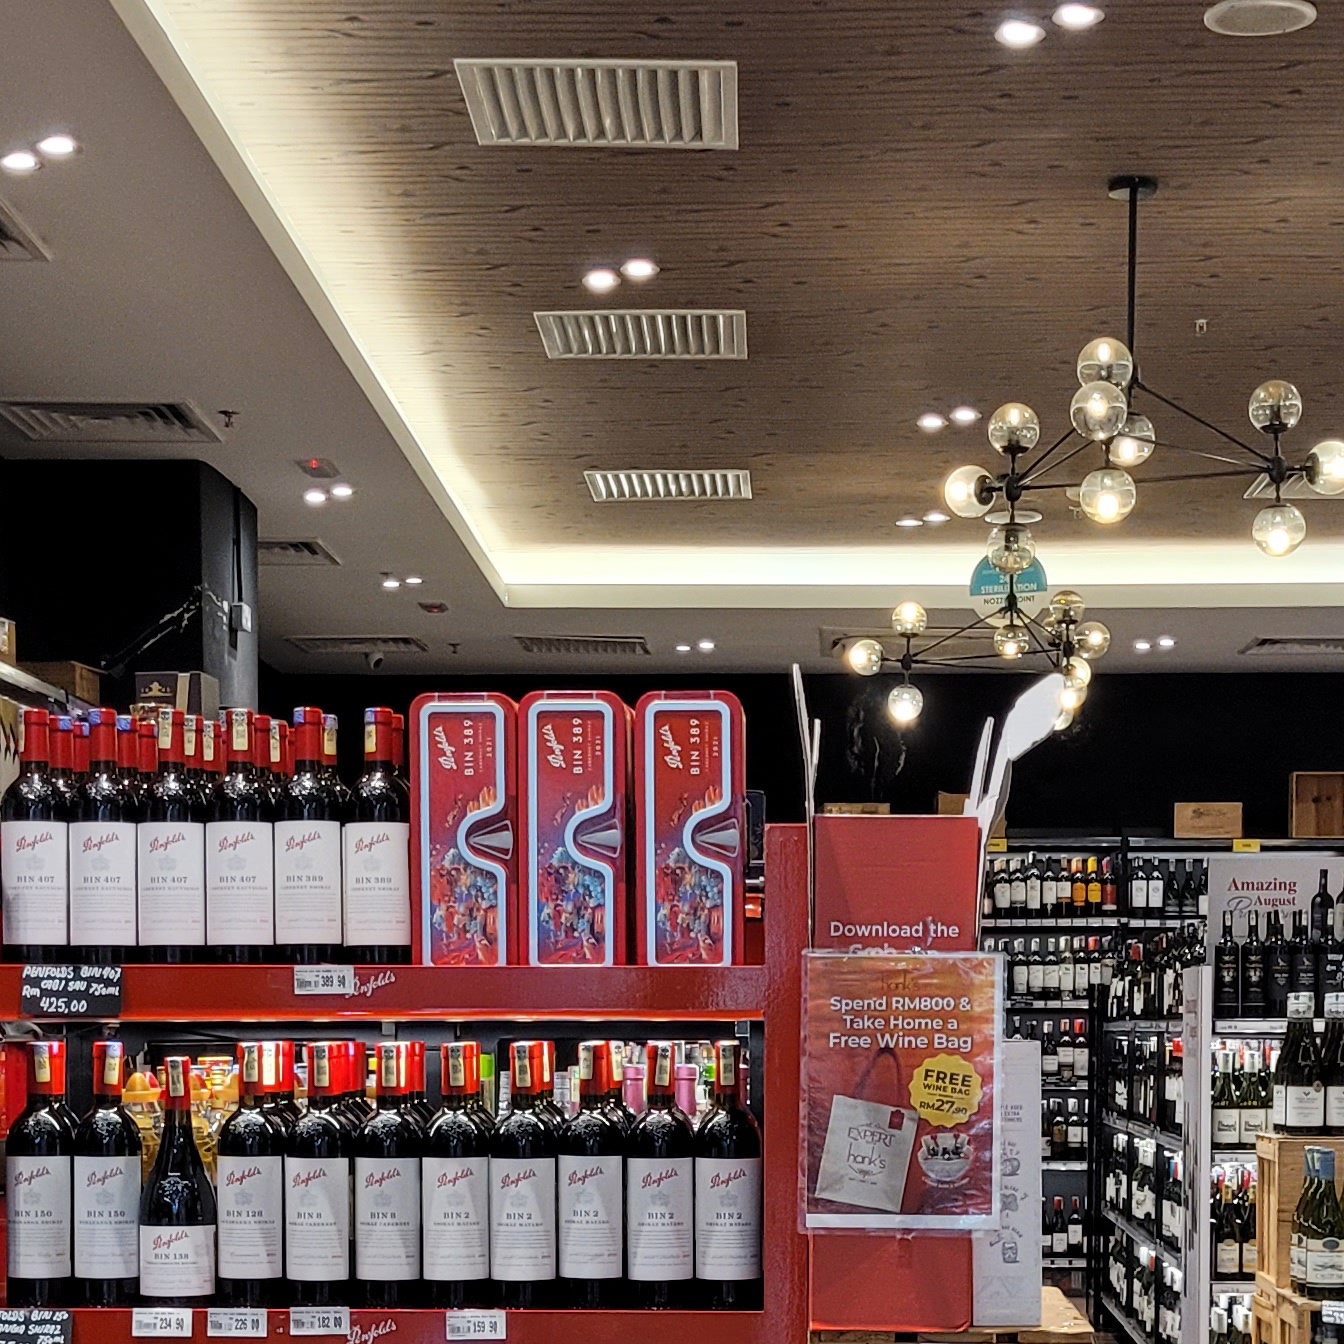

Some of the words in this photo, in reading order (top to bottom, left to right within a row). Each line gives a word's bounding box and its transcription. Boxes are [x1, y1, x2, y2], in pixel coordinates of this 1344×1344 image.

[464, 720, 474, 744] 389
[573, 717, 583, 743] 389
[690, 718, 700, 743] 389
[464, 752, 475, 776] BIN
[573, 751, 583, 774] BIN
[690, 751, 700, 775] BIN
[1227, 877, 1297, 894] Amazing
[1254, 895, 1296, 910] August
[830, 921, 923, 937] Download
[929, 922, 959, 937] the
[22, 966, 74, 979] PENFOLDS
[80, 966, 102, 978] BIN
[321, 976, 334, 987] 389
[830, 996, 886, 1013] Spend
[892, 997, 954, 1010] RM800
[960, 998, 971, 1010] &
[843, 1016, 885, 1029] Take
[890, 1016, 942, 1029] Home
[948, 1019, 957, 1029] a
[829, 1033, 871, 1048] Free
[877, 1033, 928, 1048] Wine
[934, 1034, 972, 1052] Bag
[924, 1069, 972, 1087] FREE
[923, 1083, 947, 1092] WINE
[951, 1087, 970, 1096] BAG
[847, 1142, 886, 1169] hank's
[648, 1212, 666, 1220] BIN
[159, 1317, 172, 1330] 234
[317, 1316, 330, 1329] 182
